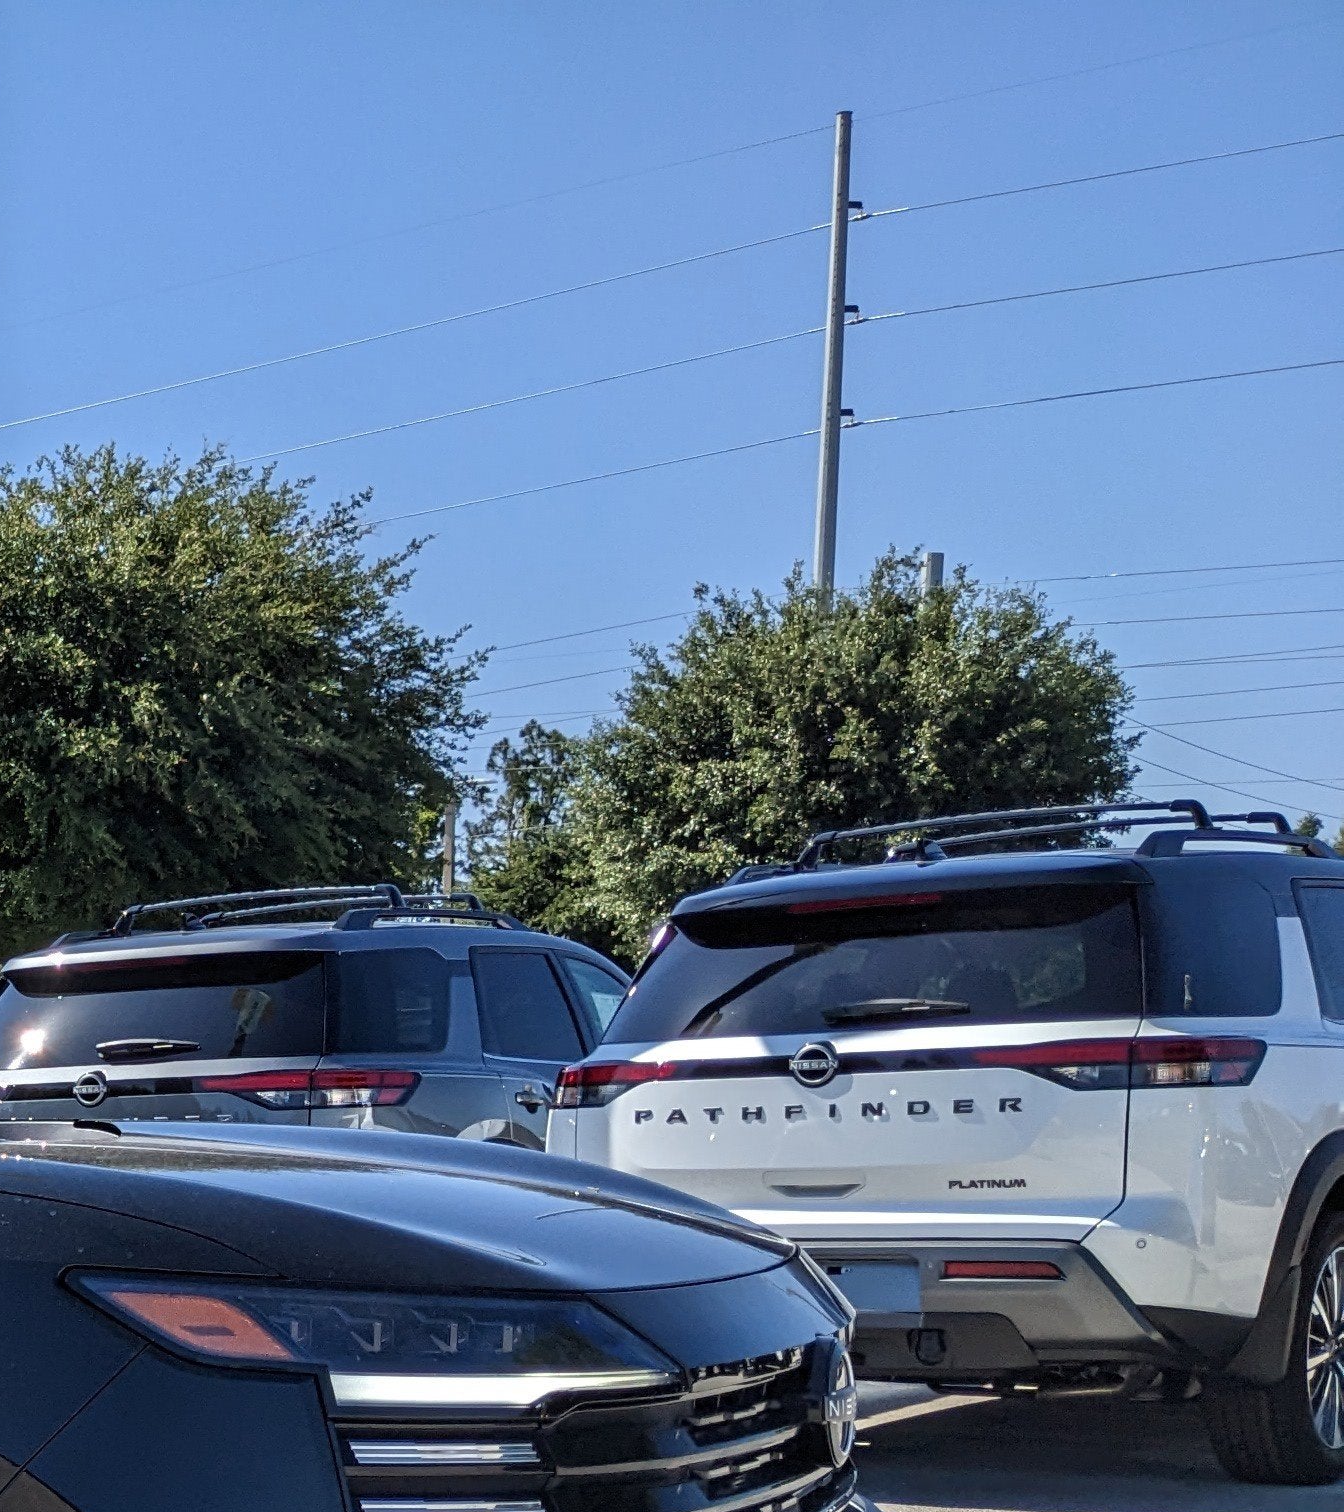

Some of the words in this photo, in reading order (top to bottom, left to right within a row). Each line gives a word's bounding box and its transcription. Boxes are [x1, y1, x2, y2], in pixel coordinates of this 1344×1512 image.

[790, 1060, 838, 1070] NISSAN
[634, 1097, 1023, 1125] PATHFINDER
[948, 1179, 1027, 1190] PLATINUM
